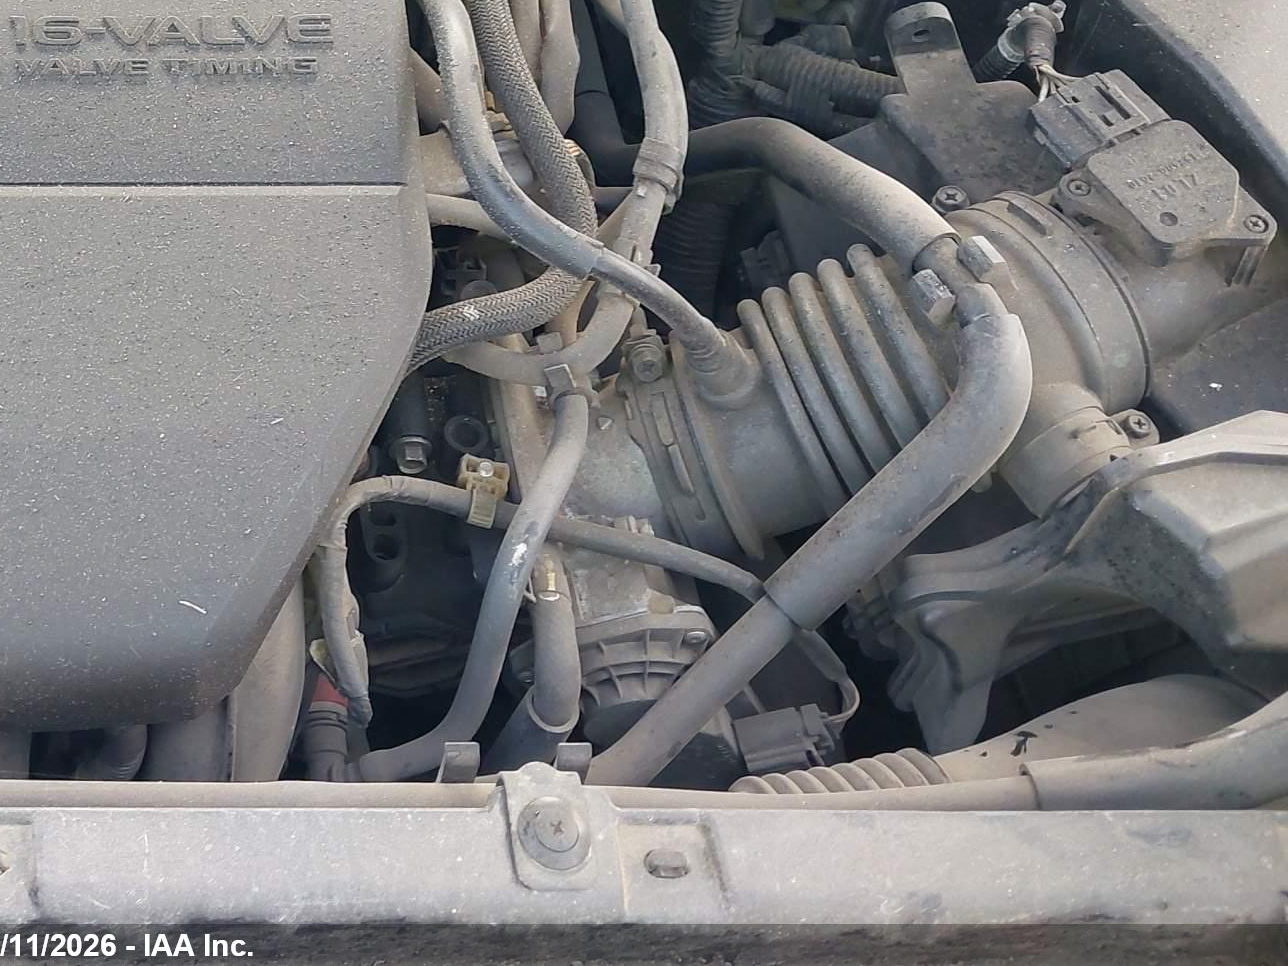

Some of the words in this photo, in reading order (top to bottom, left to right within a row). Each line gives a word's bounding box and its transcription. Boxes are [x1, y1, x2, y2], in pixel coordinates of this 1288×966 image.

[9, 13, 334, 48] 16-VALVE
[14, 57, 150, 78] VALVE
[161, 56, 318, 77] TIMING
